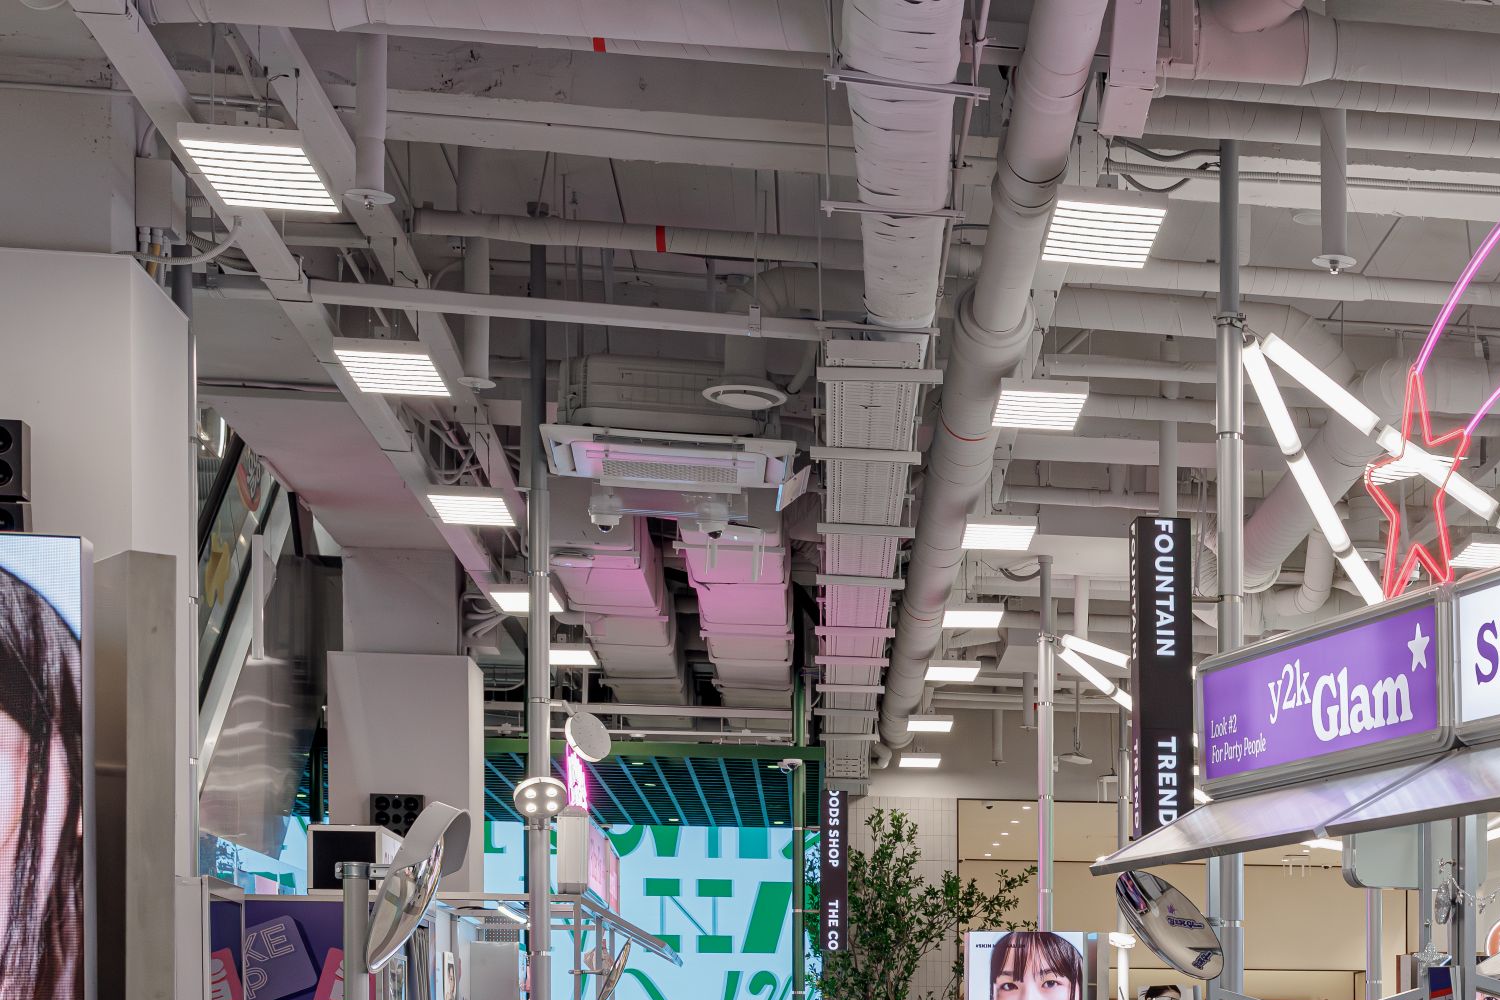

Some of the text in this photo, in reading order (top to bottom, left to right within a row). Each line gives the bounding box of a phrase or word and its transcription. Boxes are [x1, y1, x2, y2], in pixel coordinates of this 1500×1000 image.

[1154, 519, 1176, 657] FOUNTAIN
[1210, 714, 1238, 739] Look #2
[1268, 658, 1414, 742] y2k Glam
[1157, 736, 1179, 827] TREND
[1211, 732, 1267, 764] For Party People
[829, 790, 840, 868] ODS SHOP
[828, 899, 839, 928] THE
